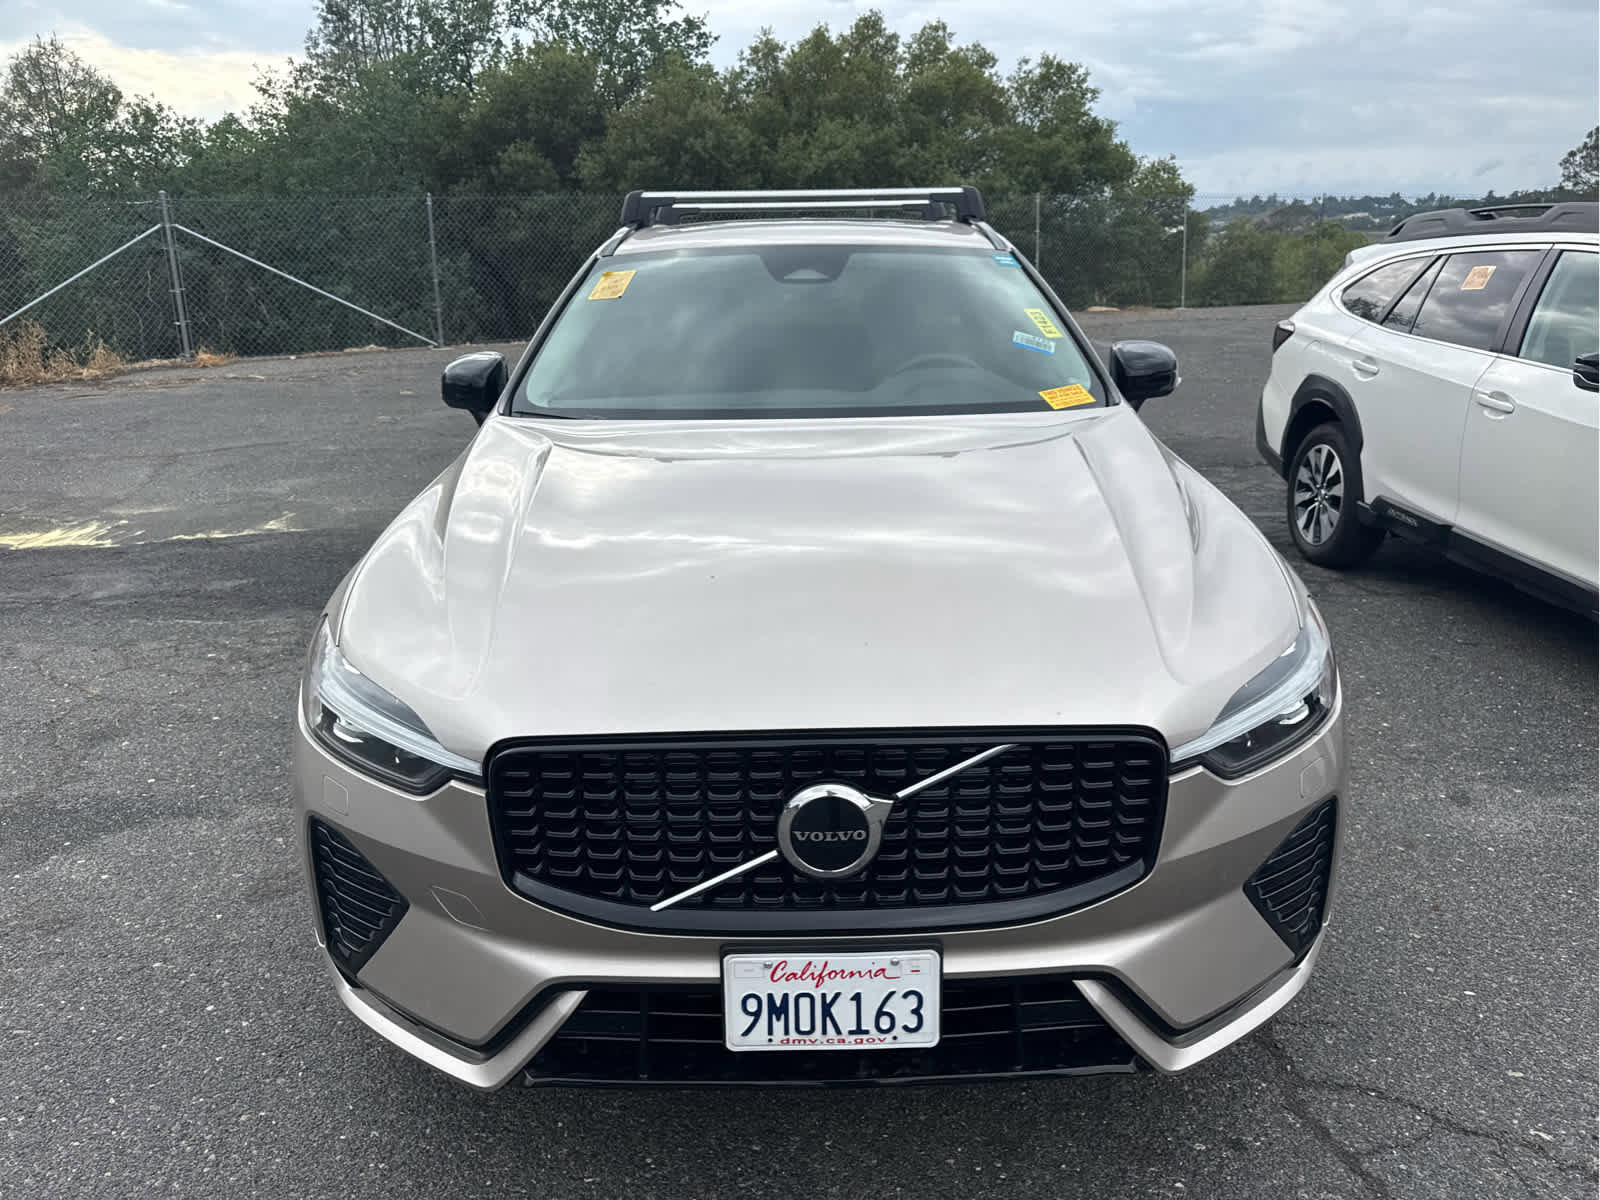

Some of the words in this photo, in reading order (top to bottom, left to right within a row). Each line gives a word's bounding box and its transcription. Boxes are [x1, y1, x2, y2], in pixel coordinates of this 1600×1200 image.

[792, 829, 867, 842] VOLVO
[769, 960, 901, 989] California
[740, 989, 925, 1037] 9MOK163
[780, 1035, 888, 1046] dmv.ca.gov
